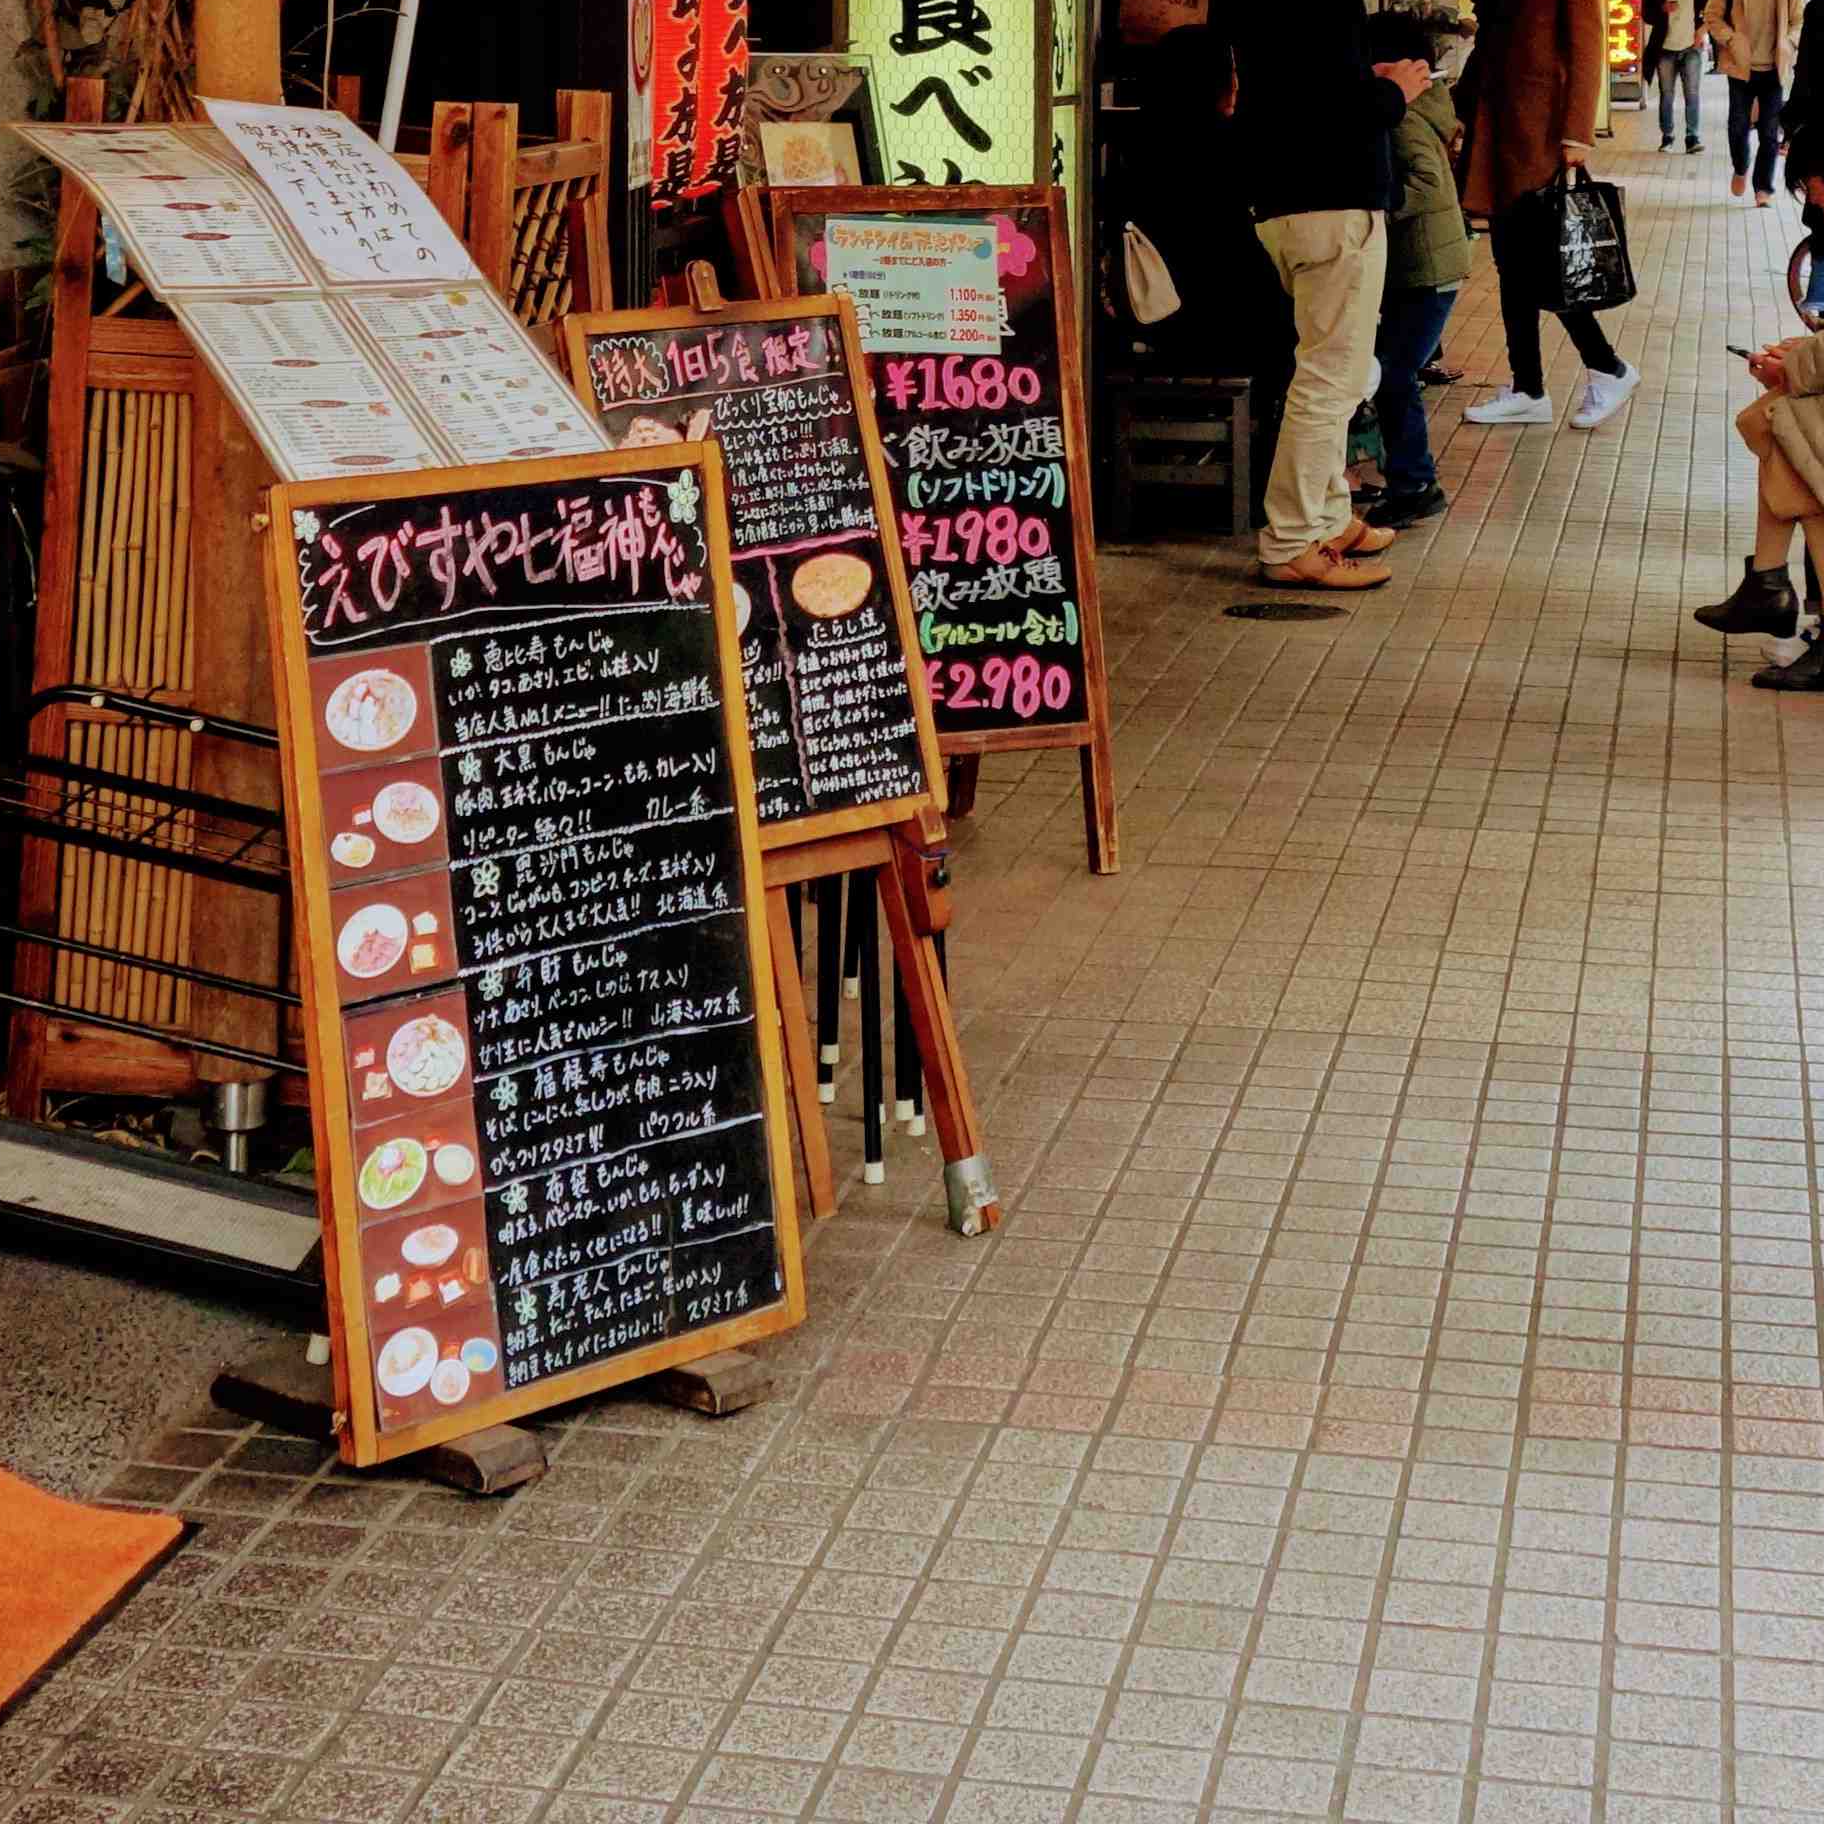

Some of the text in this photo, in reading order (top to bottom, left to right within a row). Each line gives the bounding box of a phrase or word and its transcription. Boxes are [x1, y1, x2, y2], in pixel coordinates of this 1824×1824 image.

[885, 355, 1042, 411] ¥1680
[909, 554, 1066, 612] 飲み放題
